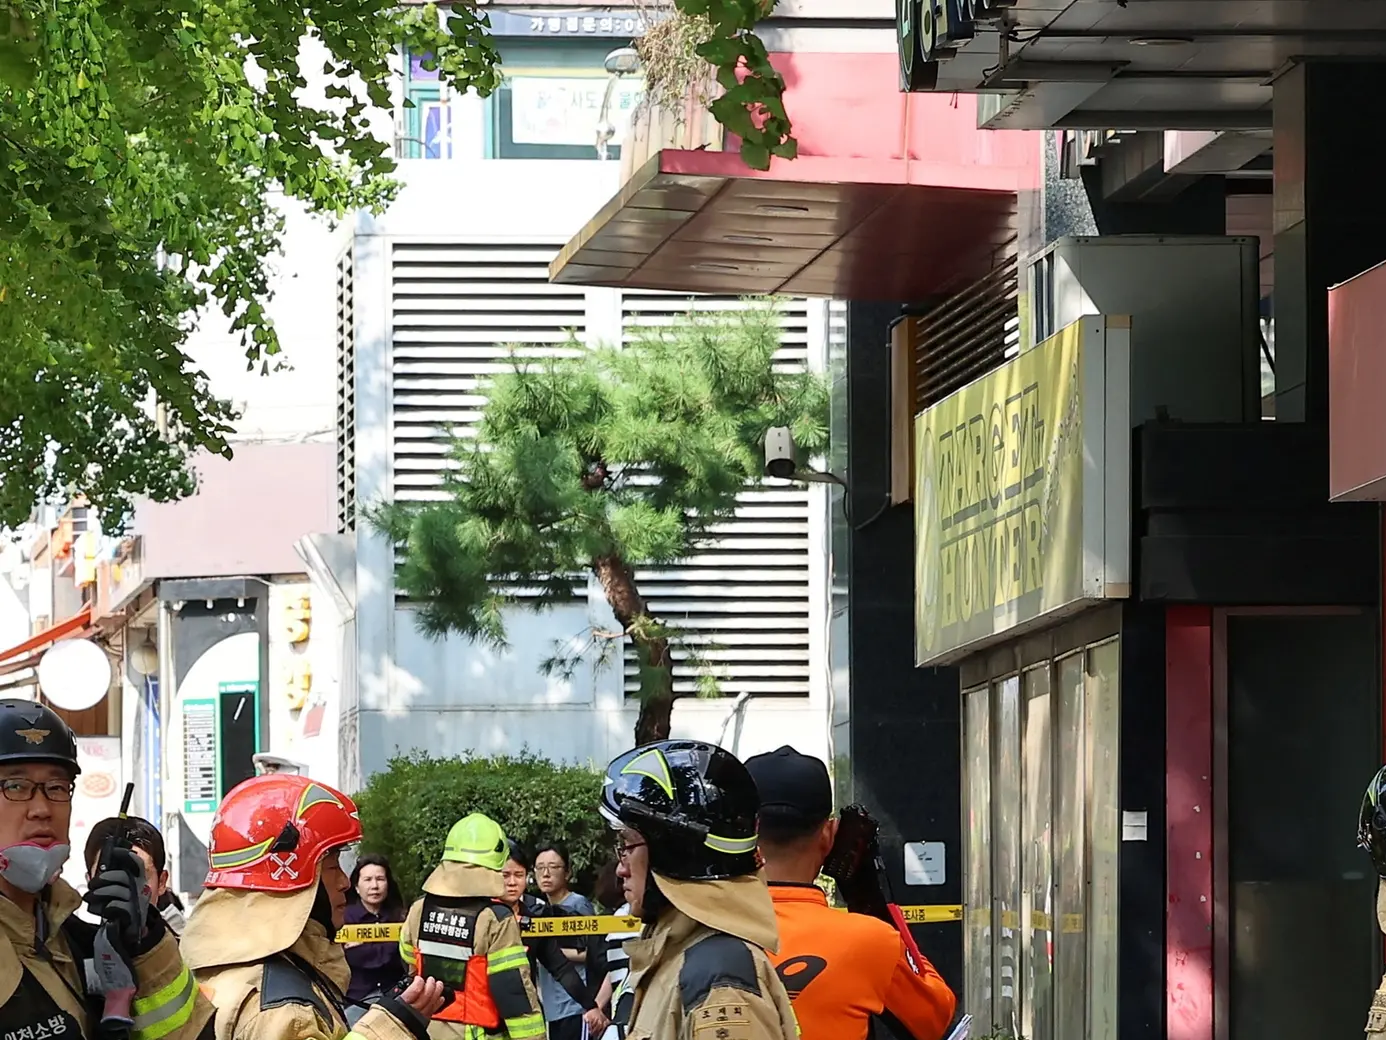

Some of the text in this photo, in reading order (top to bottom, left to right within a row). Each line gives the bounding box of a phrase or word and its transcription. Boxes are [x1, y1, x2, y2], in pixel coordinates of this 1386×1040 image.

[939, 382, 1044, 530] TARGET
[940, 498, 1043, 629] HUNTER
[901, 908, 926, 922] 조사중
[356, 927, 372, 939] FIRE
[374, 926, 390, 939] LINE
[537, 921, 554, 933] LINE
